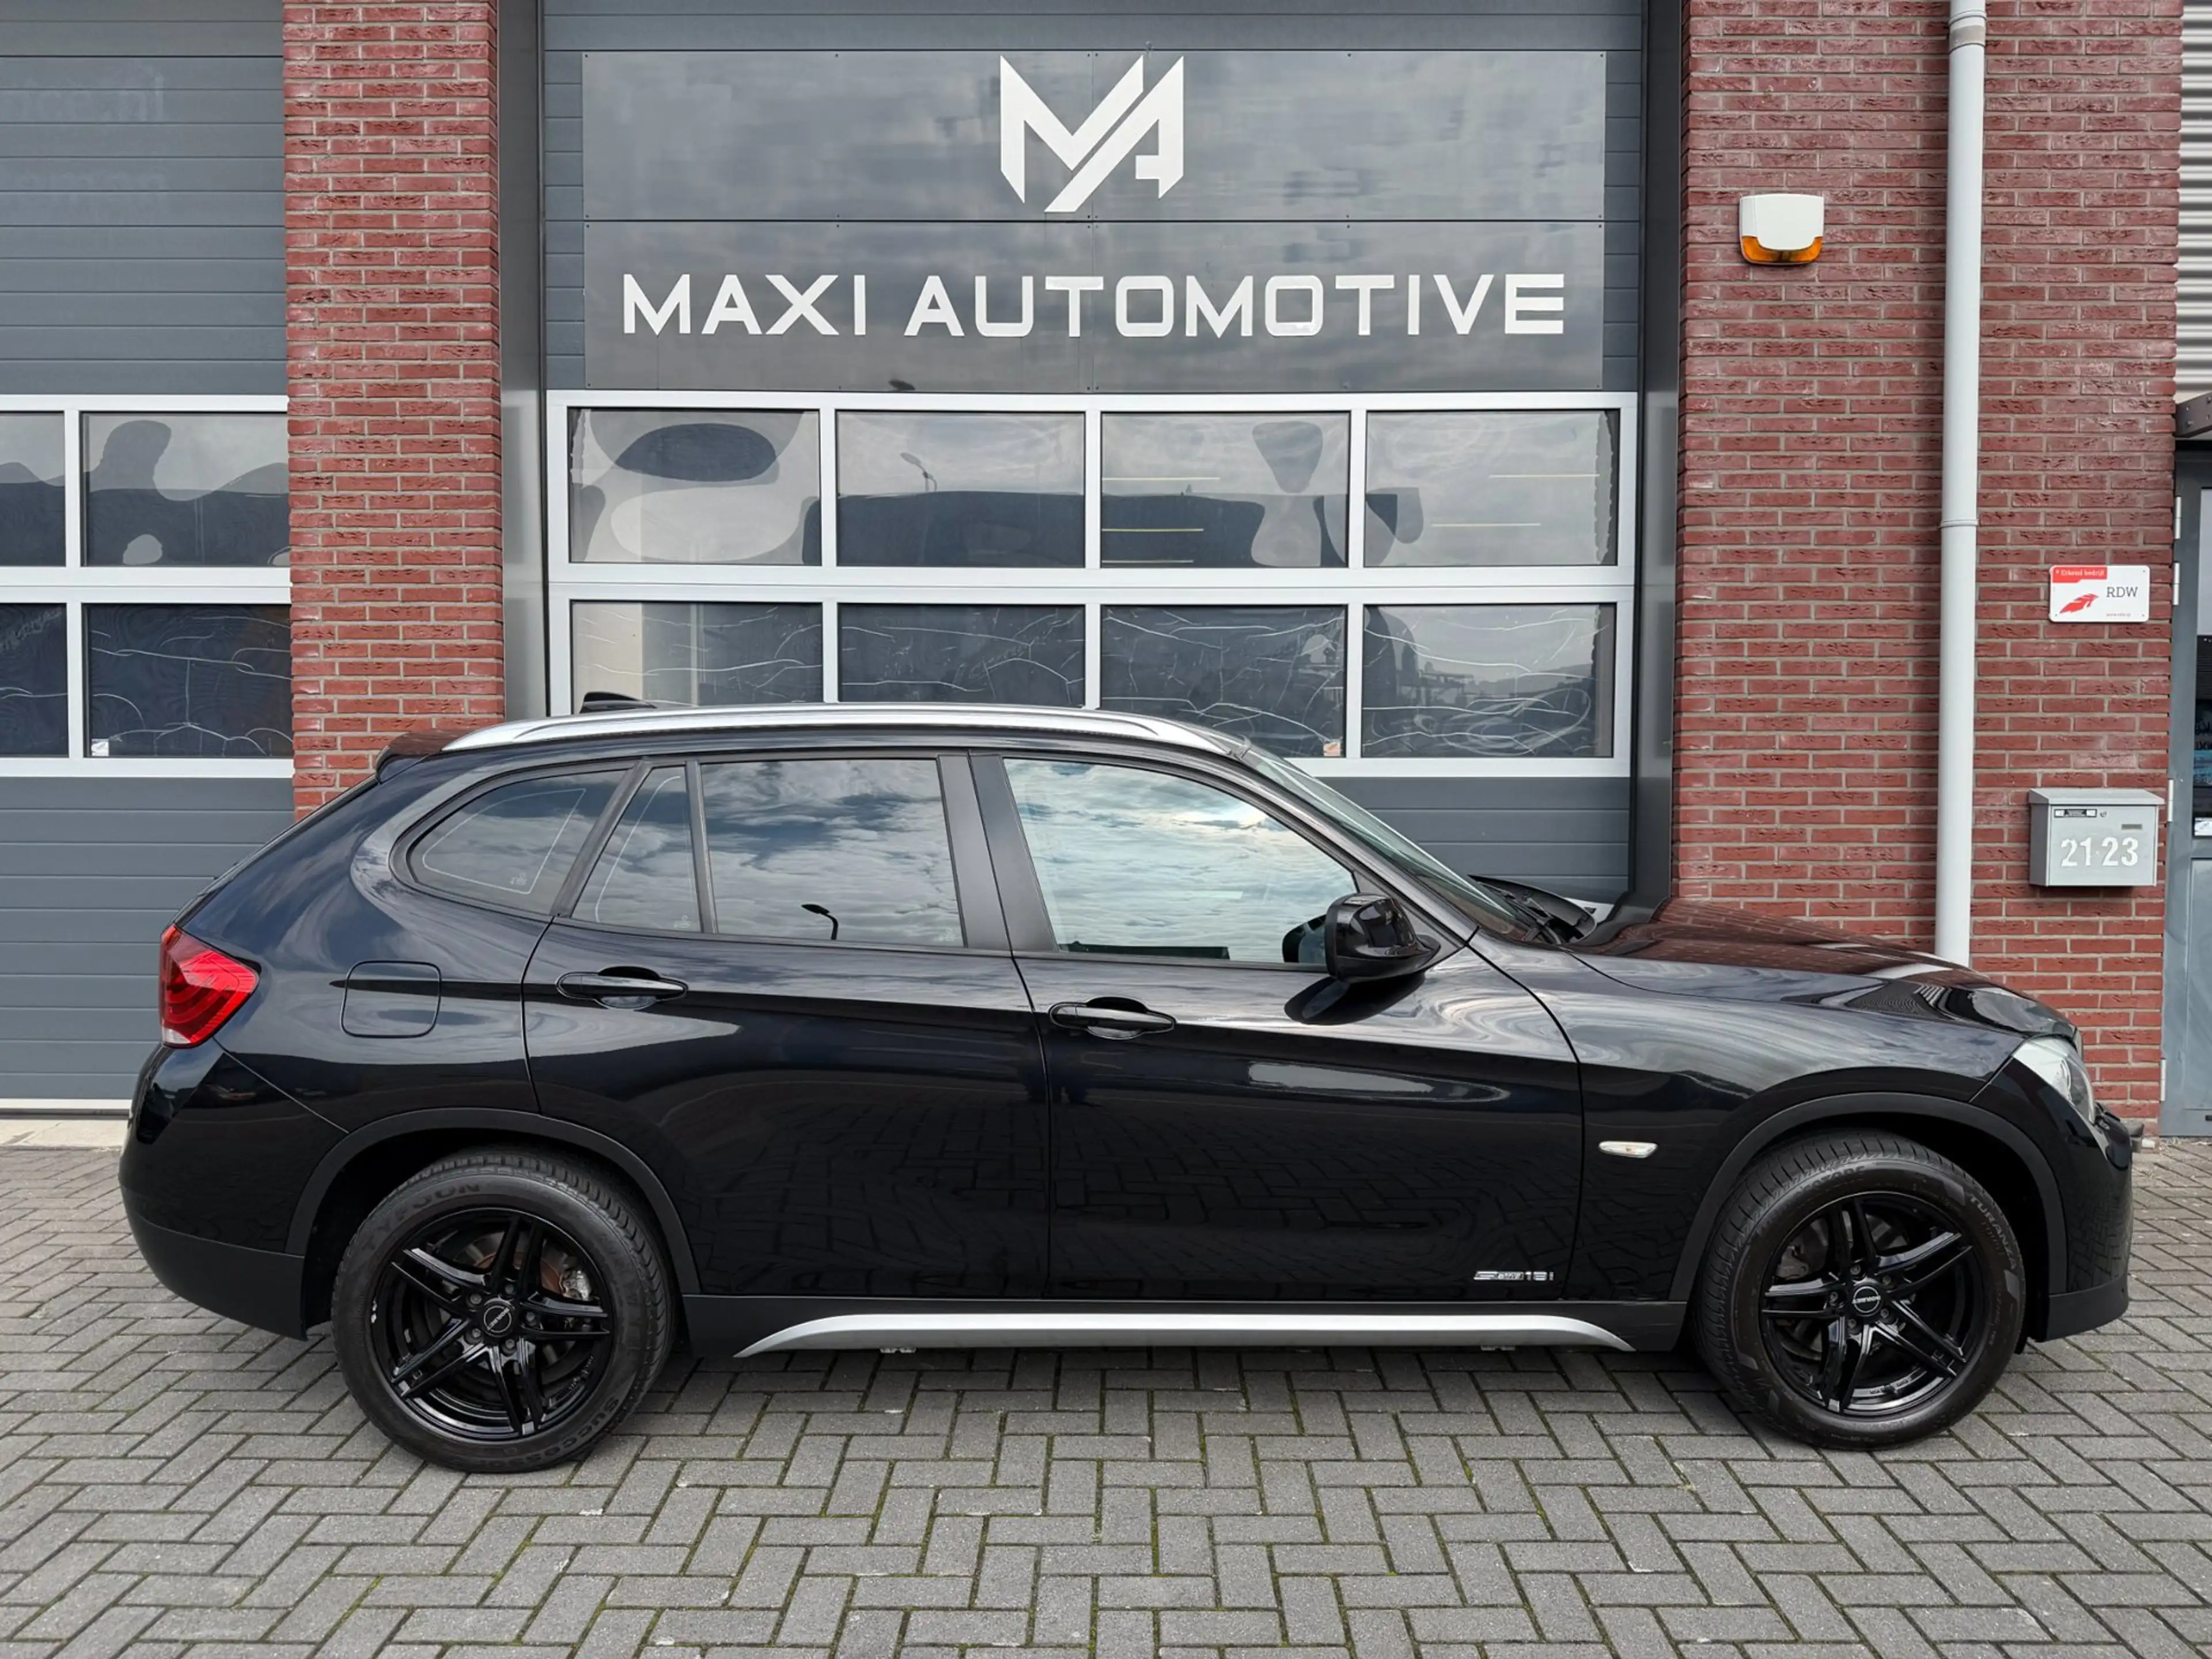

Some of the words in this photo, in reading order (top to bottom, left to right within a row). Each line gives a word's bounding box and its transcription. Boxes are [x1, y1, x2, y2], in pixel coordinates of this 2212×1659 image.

[624, 274, 866, 335] MAXI
[904, 274, 1565, 338] AUTOMOTIVE
[2106, 586, 2138, 598] RDW
